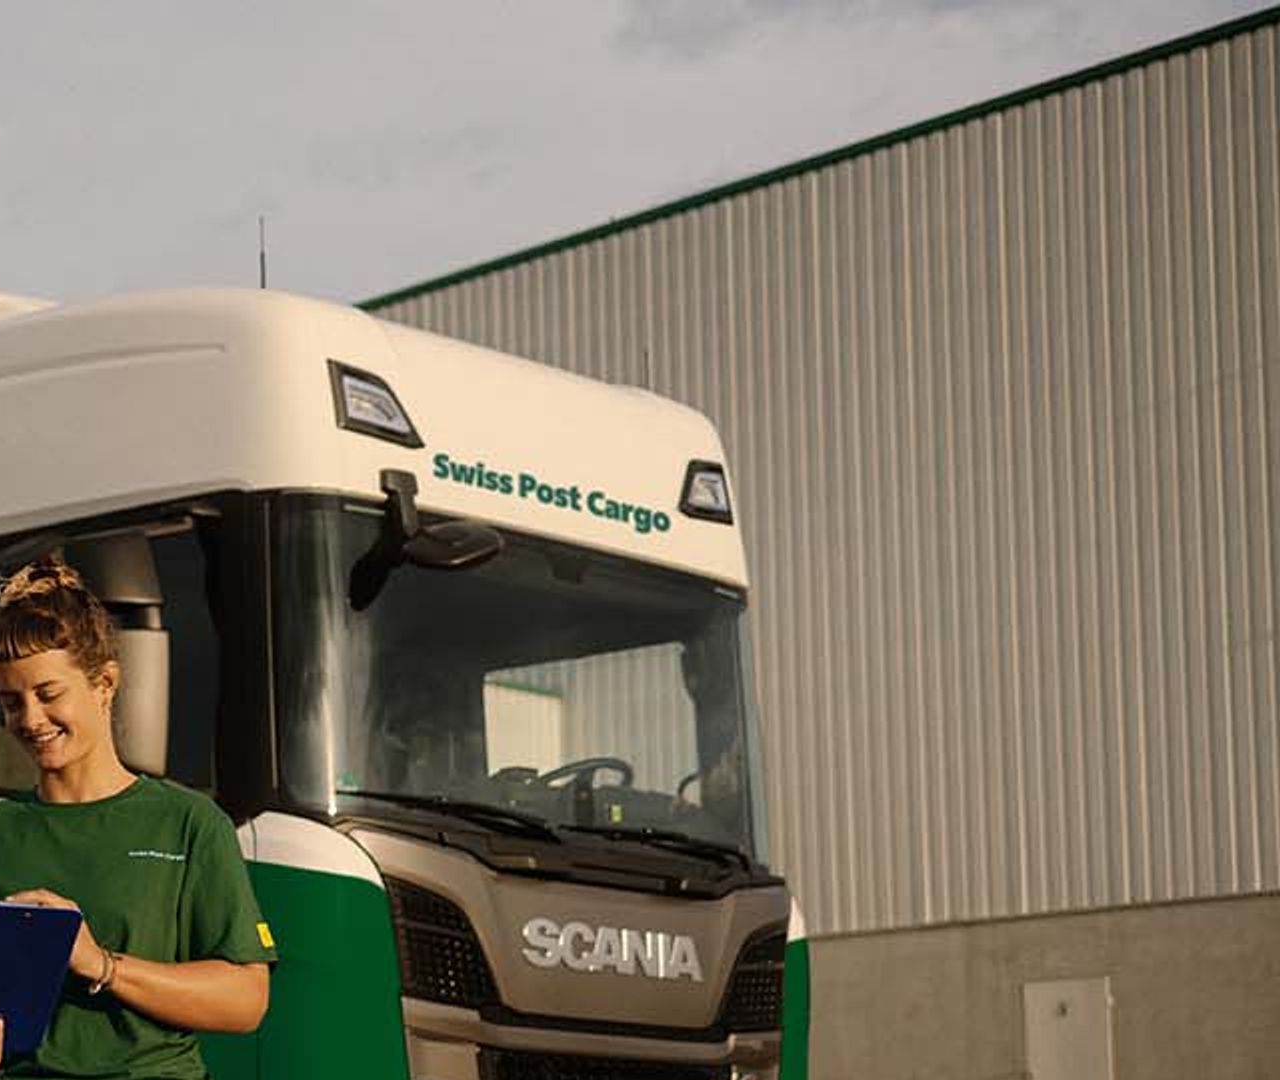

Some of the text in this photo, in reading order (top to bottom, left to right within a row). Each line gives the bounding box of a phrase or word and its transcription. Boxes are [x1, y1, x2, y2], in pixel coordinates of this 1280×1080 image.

[433, 453, 671, 533] Swiss Post Cargo
[522, 917, 704, 982] SCANIA
